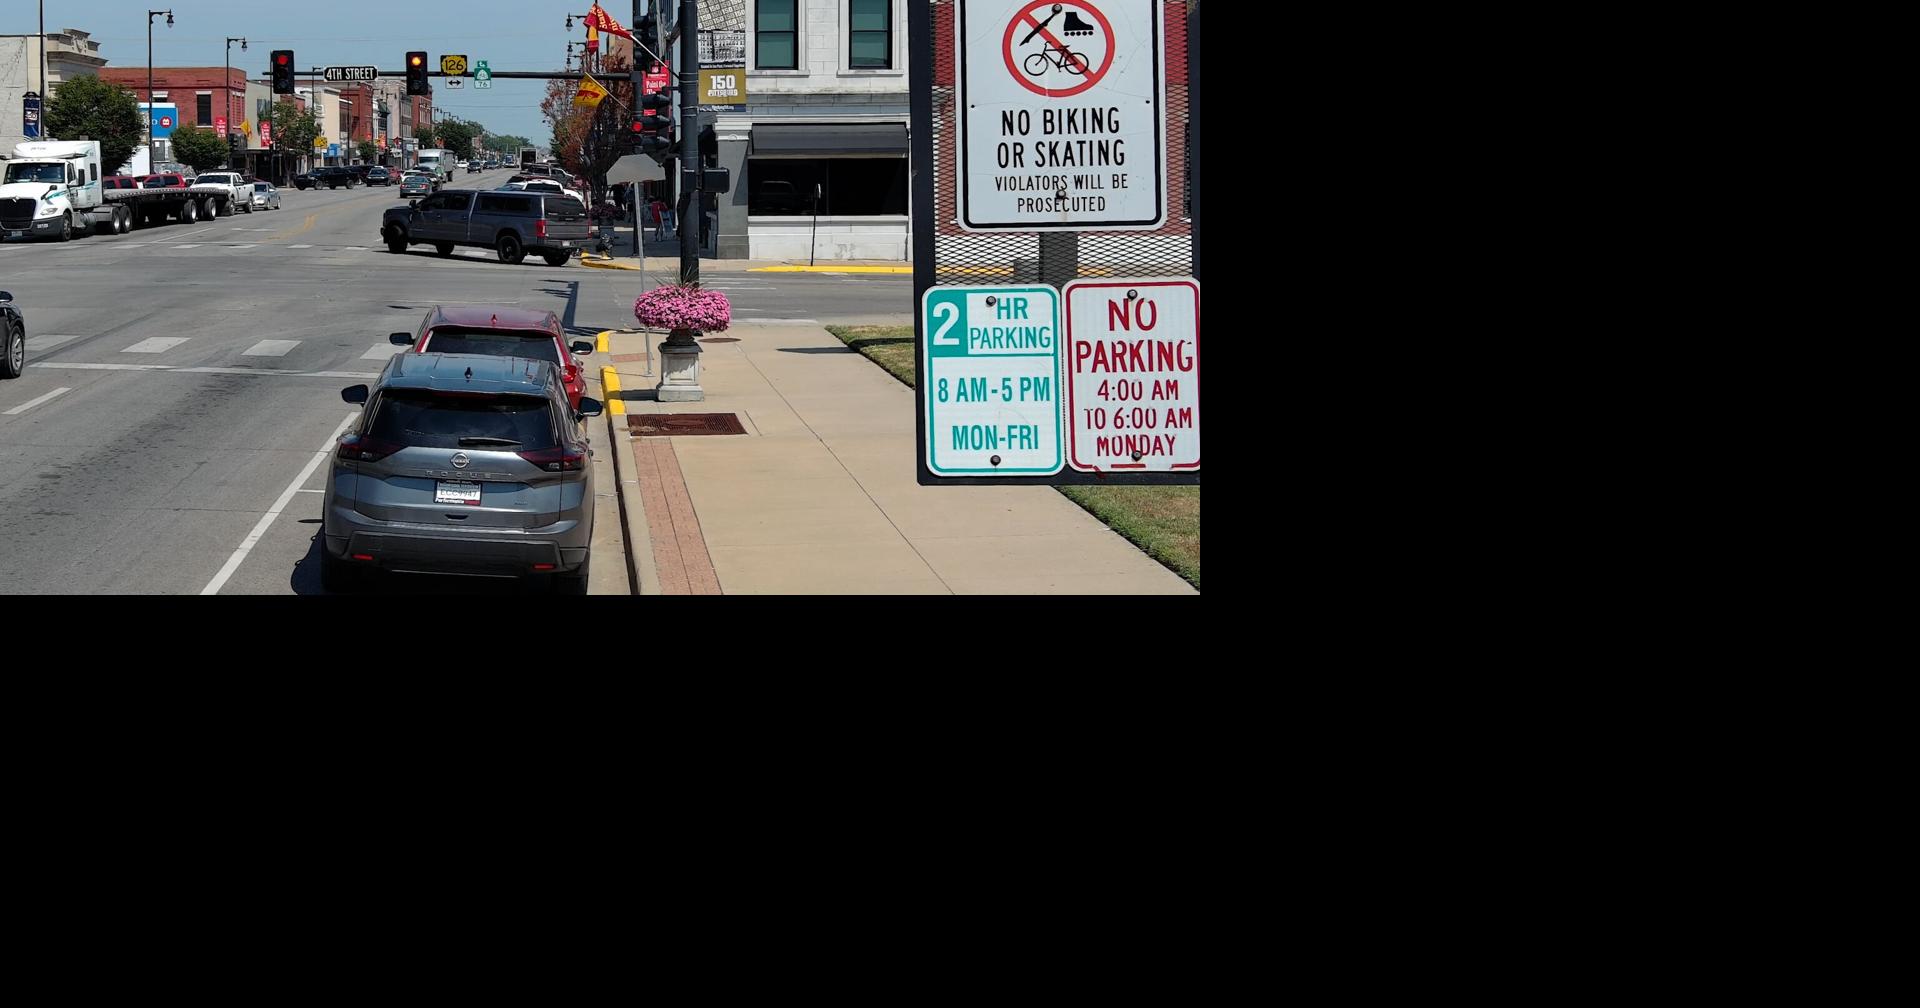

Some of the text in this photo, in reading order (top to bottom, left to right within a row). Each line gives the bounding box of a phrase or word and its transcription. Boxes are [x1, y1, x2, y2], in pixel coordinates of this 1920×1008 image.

[326, 67, 374, 80] 4TH STREET
[444, 60, 463, 71] 126
[710, 75, 735, 89] 150
[1002, 107, 1120, 136] NO BIKING
[997, 139, 1125, 168] OR SKATING
[995, 173, 1128, 191] VIOLATORS WILL BE
[1017, 196, 1106, 213] PROSECUTED
[996, 297, 1028, 320] HR
[1108, 298, 1157, 331] NO
[932, 301, 960, 346] 2
[969, 326, 1051, 350] PARKING
[1076, 339, 1193, 373] PARKING
[938, 377, 948, 403] 8
[1020, 377, 1050, 402] PM
[1097, 379, 1179, 401] 4:00 AM
[1084, 407, 1192, 430] TO 6:00 AM
[952, 424, 1039, 450] MON-FRI
[1096, 433, 1176, 457] MONDAY
